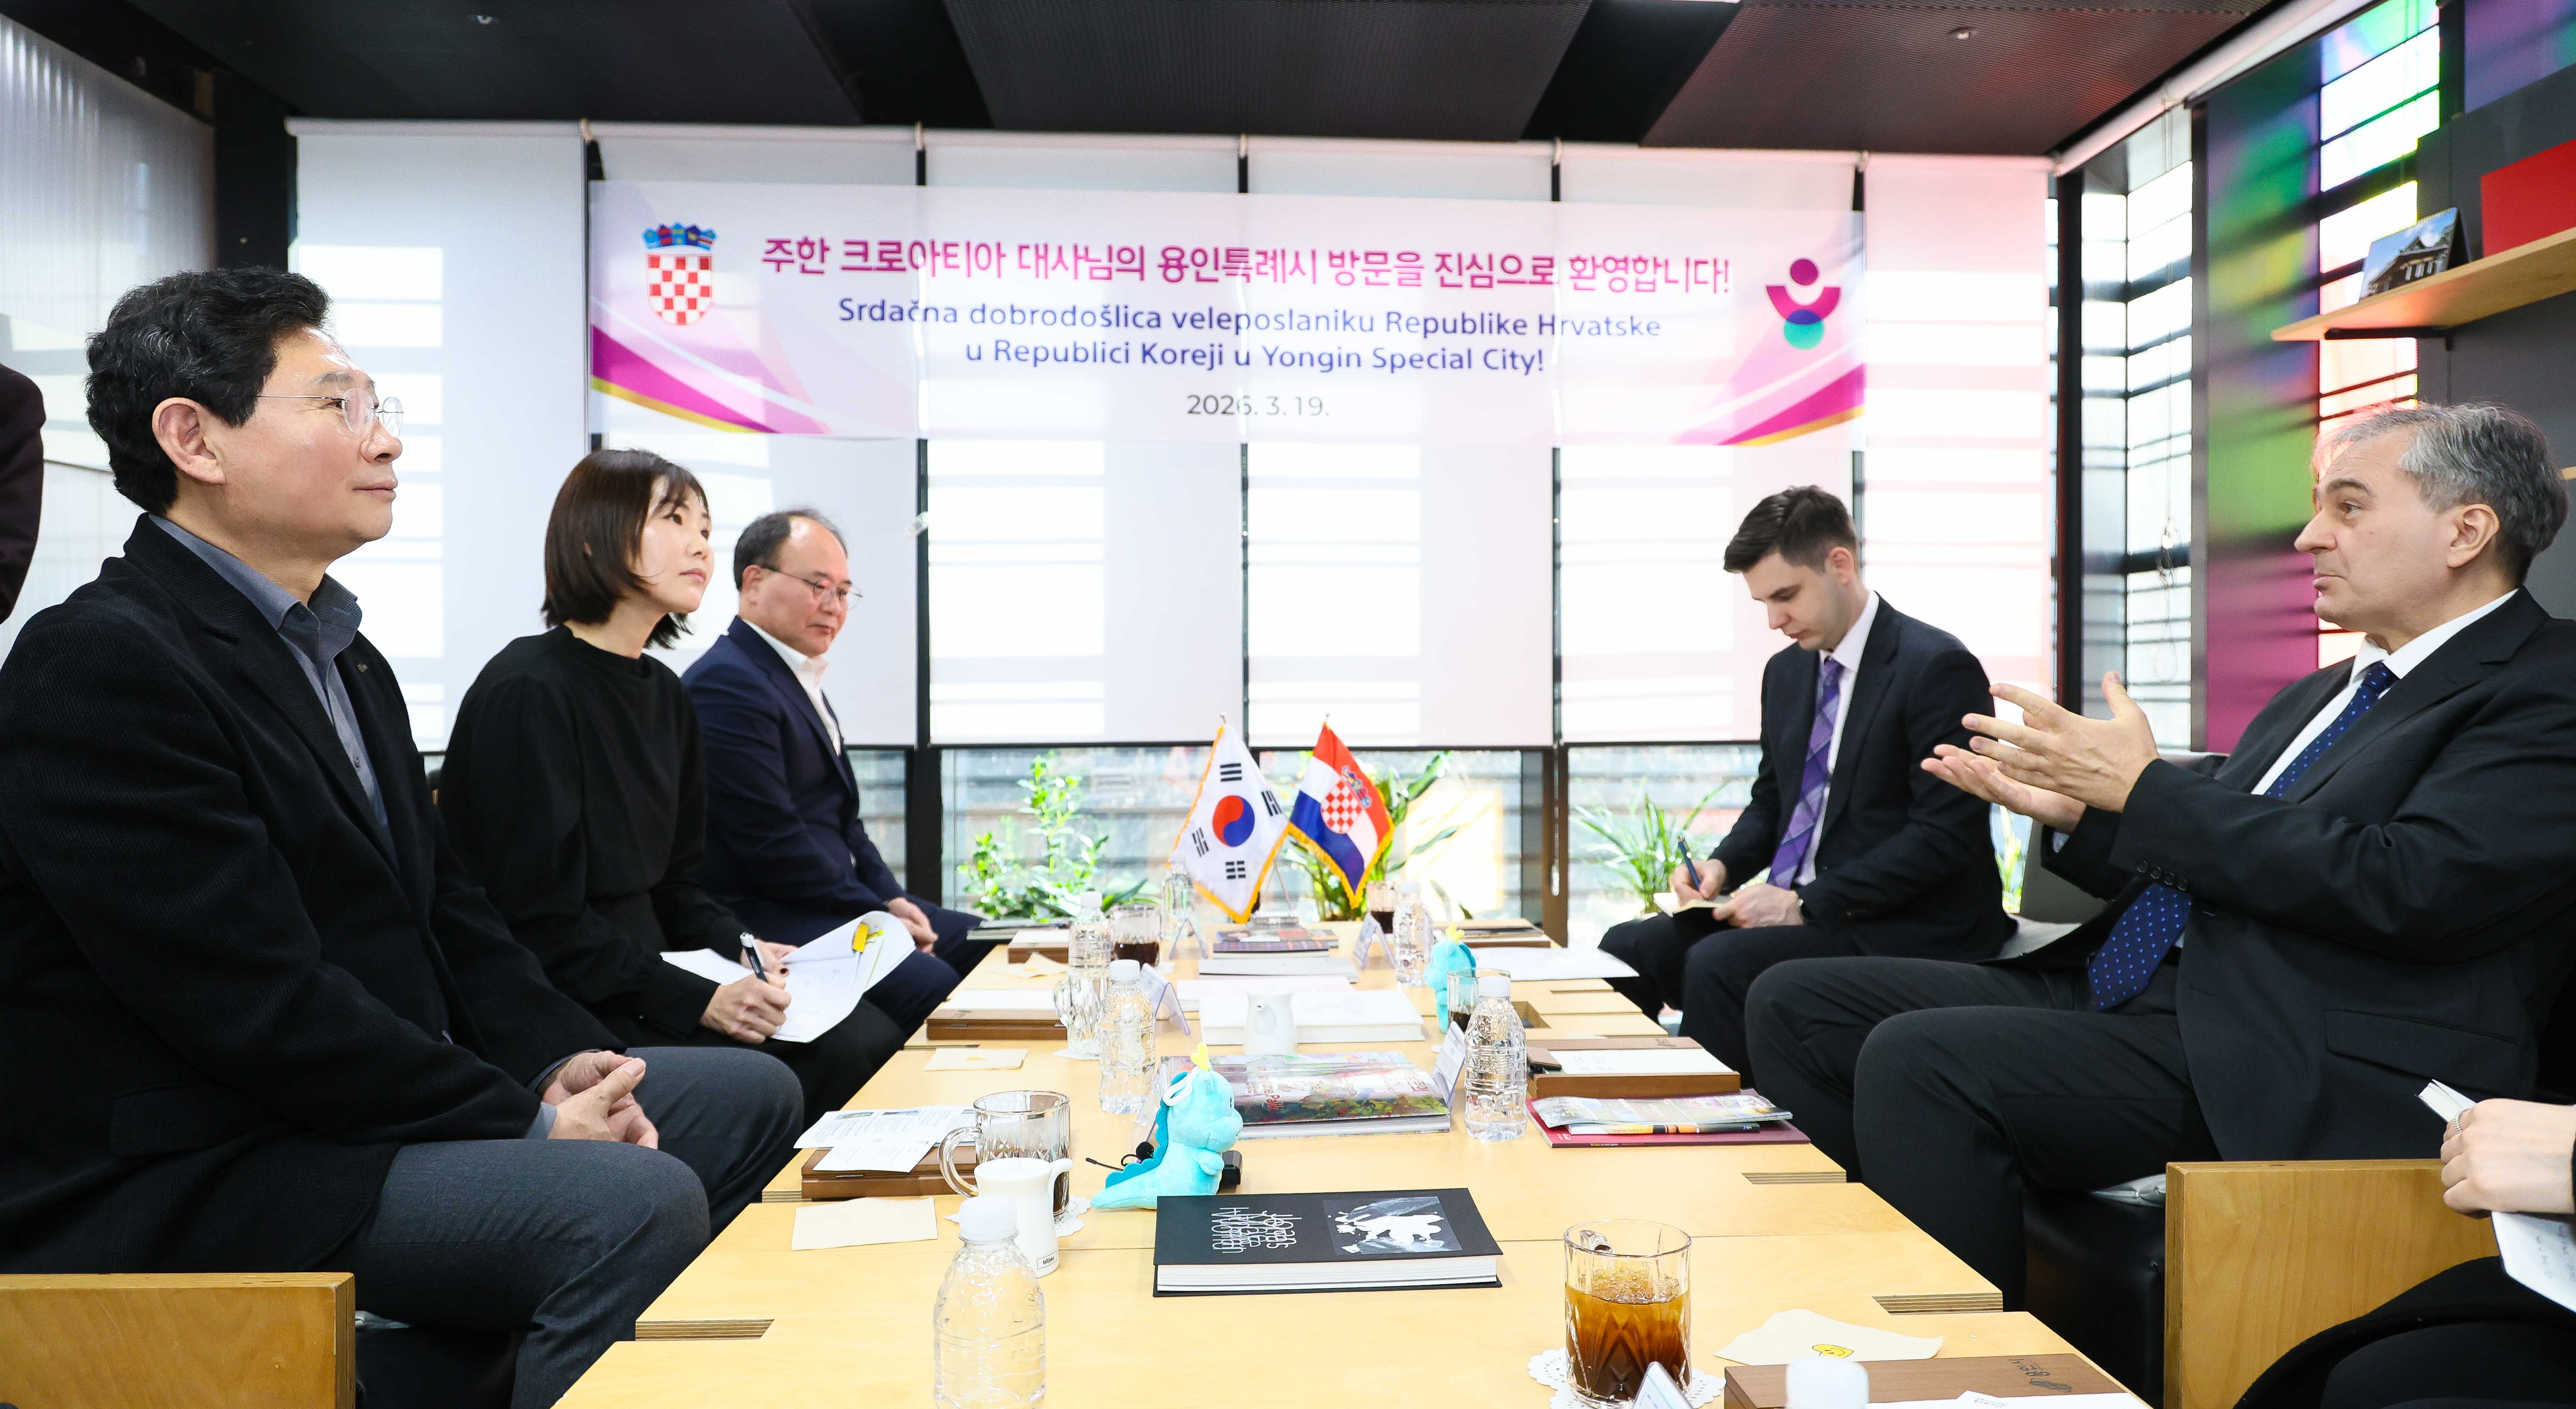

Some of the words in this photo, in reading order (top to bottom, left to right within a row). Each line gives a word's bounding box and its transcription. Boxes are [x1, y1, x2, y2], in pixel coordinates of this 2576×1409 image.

[762, 237, 829, 274] 주한
[839, 239, 1006, 278] 크로아티아
[1018, 243, 1145, 281] 대사님의
[1157, 246, 1317, 285] 용인특례시
[1329, 249, 1425, 287] 방문을
[1434, 252, 1559, 289] 진심으로
[1569, 255, 1729, 294] 환영합니다!
[839, 298, 957, 323] Srdačna
[970, 304, 1160, 328] dobrodošlica
[1172, 306, 1373, 335] veleposlaniku
[1386, 311, 1527, 339] Republike
[1539, 314, 1662, 337] Hrvatske
[966, 344, 981, 361] u
[995, 340, 1129, 367] Republici
[1142, 342, 1223, 371] Koreji
[1235, 349, 1250, 366] u
[1263, 345, 1361, 373] Yongin
[1373, 347, 1472, 374] Special
[1483, 349, 1543, 375] City!
[1271, 1213, 1302, 1244] Joan
